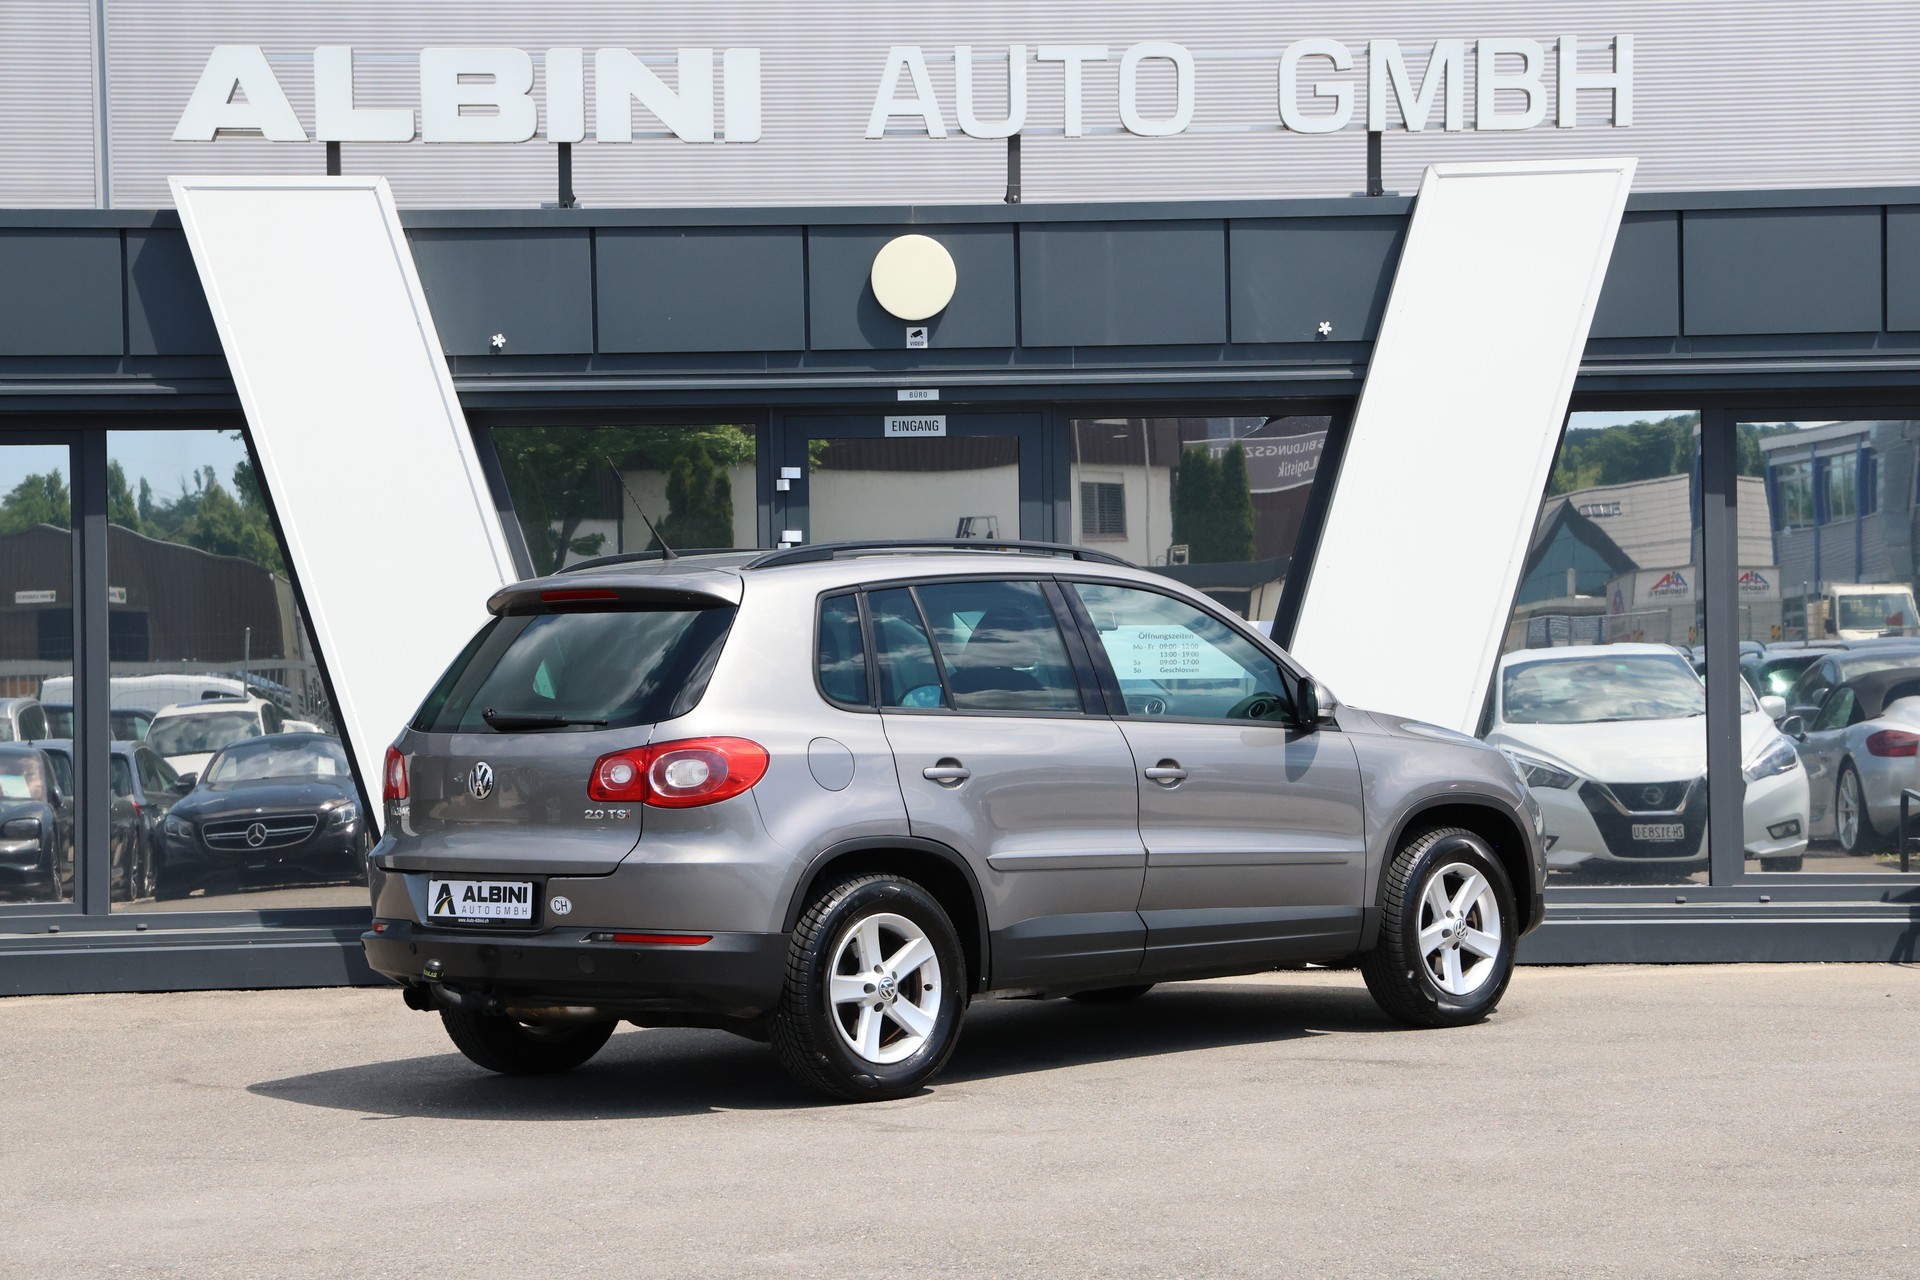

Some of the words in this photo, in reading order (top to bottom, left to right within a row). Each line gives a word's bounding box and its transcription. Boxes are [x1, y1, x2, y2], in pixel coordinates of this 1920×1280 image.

[171, 44, 763, 145] ALBINI
[865, 41, 1195, 140] AUTO
[1278, 34, 1634, 135] GMBH
[909, 391, 928, 399] BÜRO
[892, 420, 940, 432] EINGANG
[1138, 631, 1194, 641] Öffnungszeiten
[607, 809, 631, 819] TSI
[462, 885, 528, 904] ALBINI
[461, 905, 490, 915] AUTO
[495, 906, 528, 916] GMBH
[553, 899, 568, 912] CH
